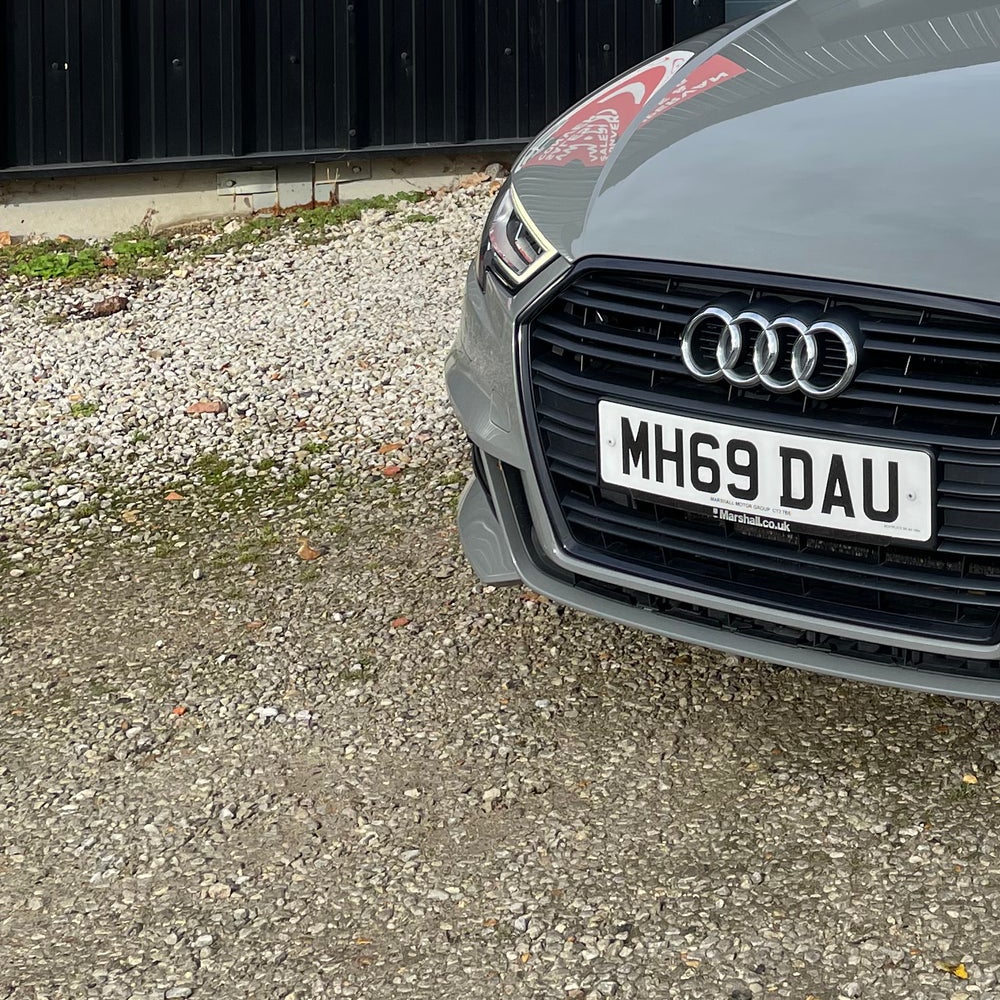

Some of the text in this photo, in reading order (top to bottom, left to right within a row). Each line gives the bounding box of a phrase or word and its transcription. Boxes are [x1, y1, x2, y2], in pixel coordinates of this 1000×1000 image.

[621, 416, 899, 523] MH69 DAU
[710, 496, 735, 506] MARSHALL
[735, 501, 753, 510] MOTOR
[719, 509, 791, 532] Marshall.co.uk
